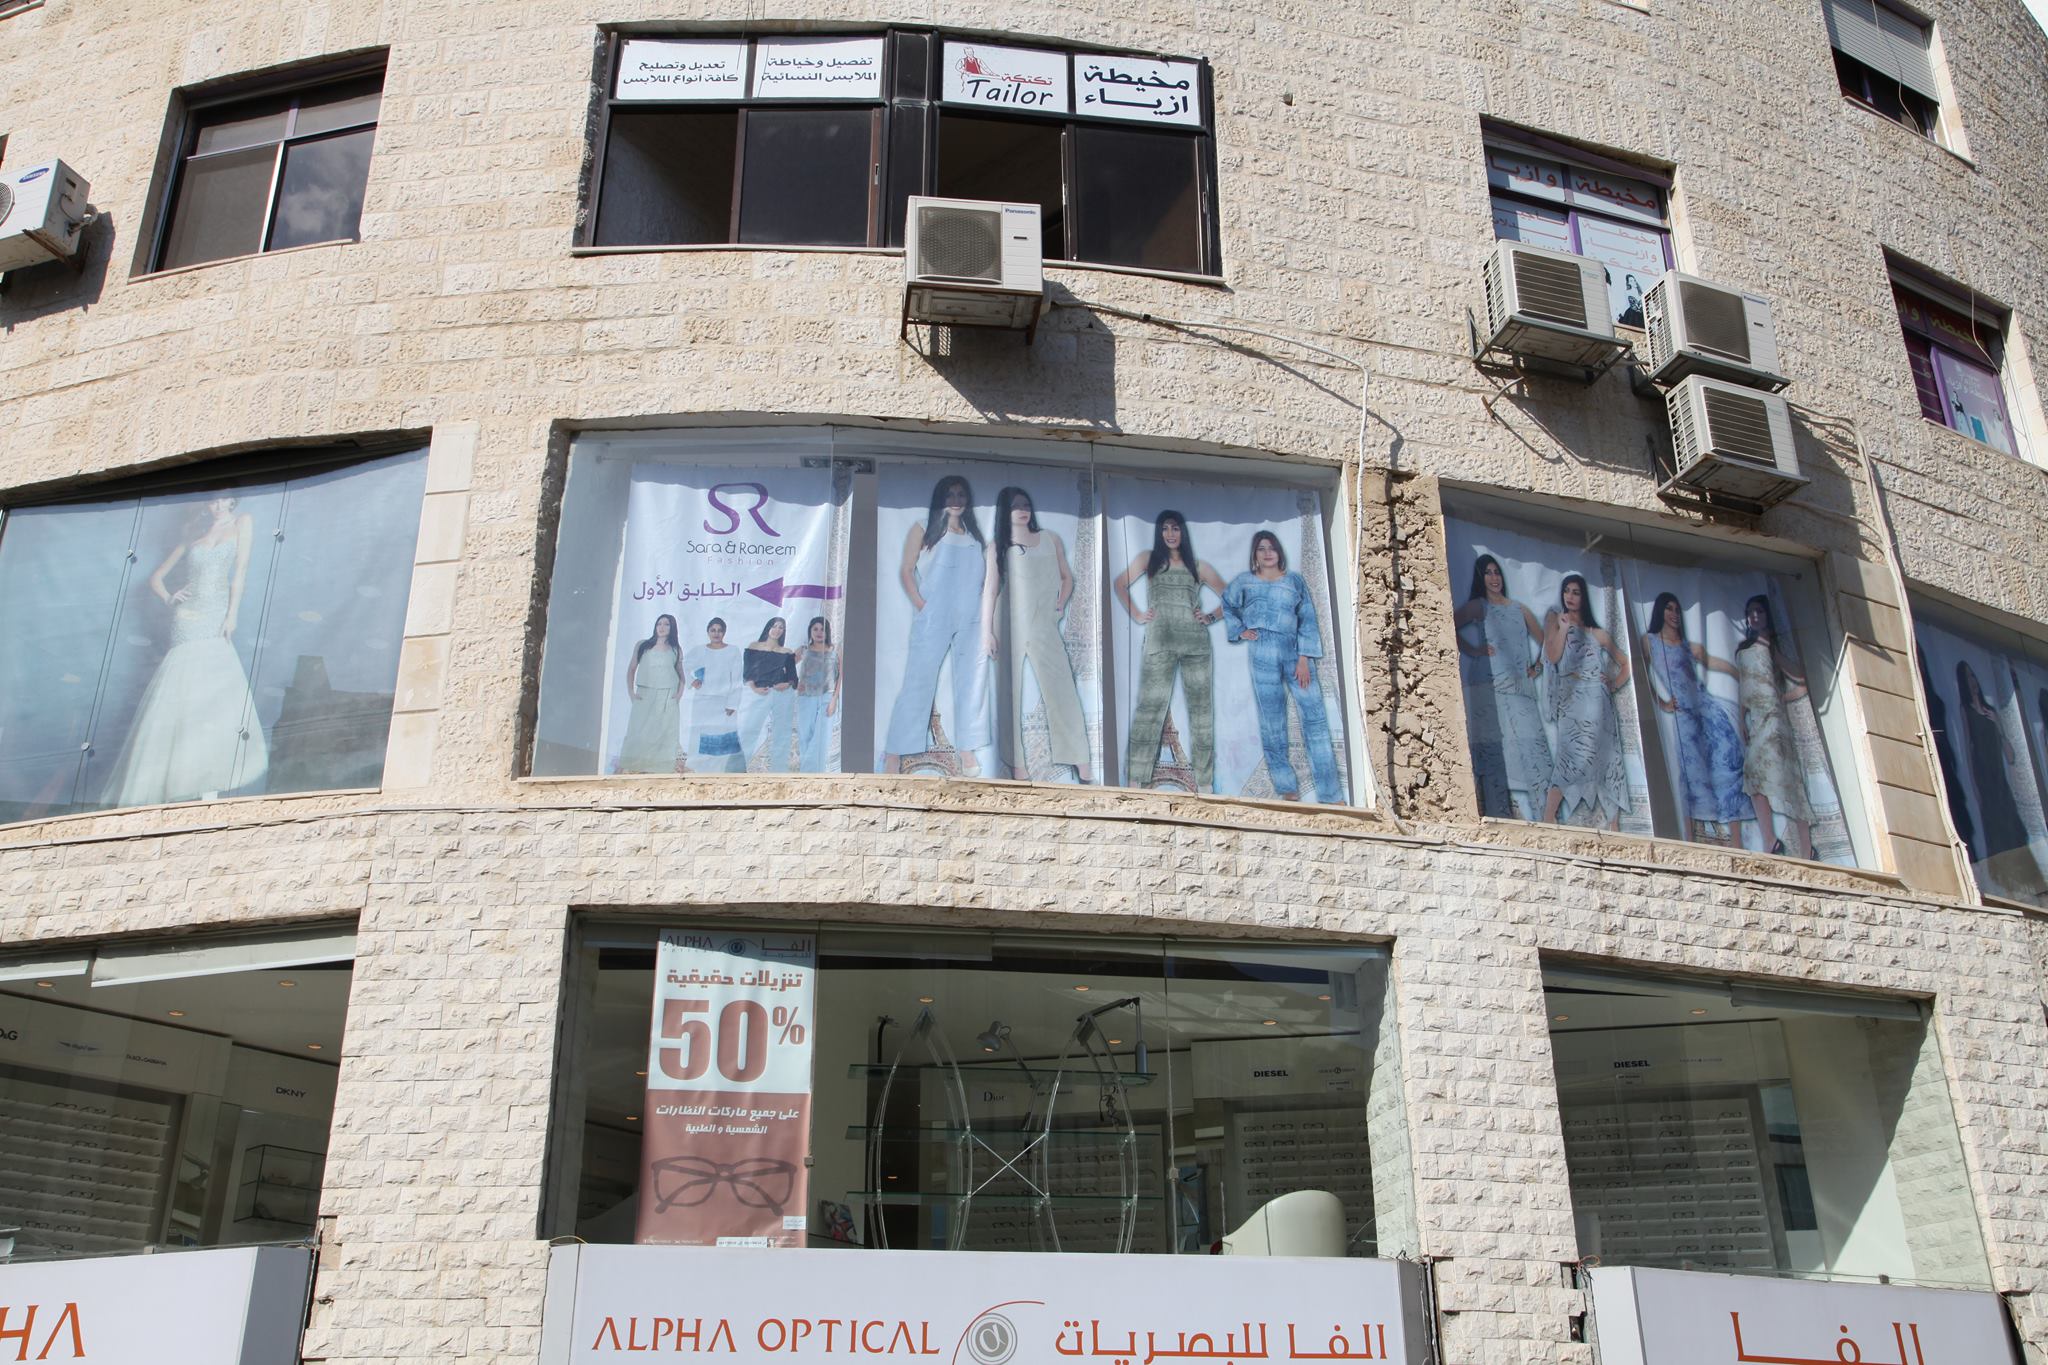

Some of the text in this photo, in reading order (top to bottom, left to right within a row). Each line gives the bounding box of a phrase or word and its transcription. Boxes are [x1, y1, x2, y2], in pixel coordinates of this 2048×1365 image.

[688, 61, 726, 71] تعديل
[826, 57, 873, 68] تفصيل
[623, 74, 670, 84] الملابس
[761, 72, 877, 83] الملابس النسائية
[1001, 73, 1053, 86] تكتكة
[1084, 65, 1190, 92] مخيطة
[967, 79, 1054, 106] Tailor
[1084, 88, 1189, 116] ازياء
[1575, 175, 1657, 210] مخيطة
[1581, 219, 1657, 246] مخيطة
[703, 482, 781, 537] SR
[686, 540, 797, 556] Sara & Raneem
[707, 556, 774, 566] Fashion
[633, 574, 741, 602] الطابق الأول
[664, 935, 713, 949] ALPHA
[666, 969, 803, 992] تنزيلات حقيقية
[1613, 1060, 1650, 1069] DIESEL
[1253, 1070, 1288, 1078] DIESEL
[275, 1086, 307, 1098] DKNY
[656, 1105, 800, 1122] على جميع ماركات النظارات
[685, 1123, 716, 1135] الطبية
[725, 1123, 768, 1135] الشمسية
[592, 1316, 941, 1355] ALPHA OPTICAL
[1055, 1319, 1388, 1365] الفا للبصريات
